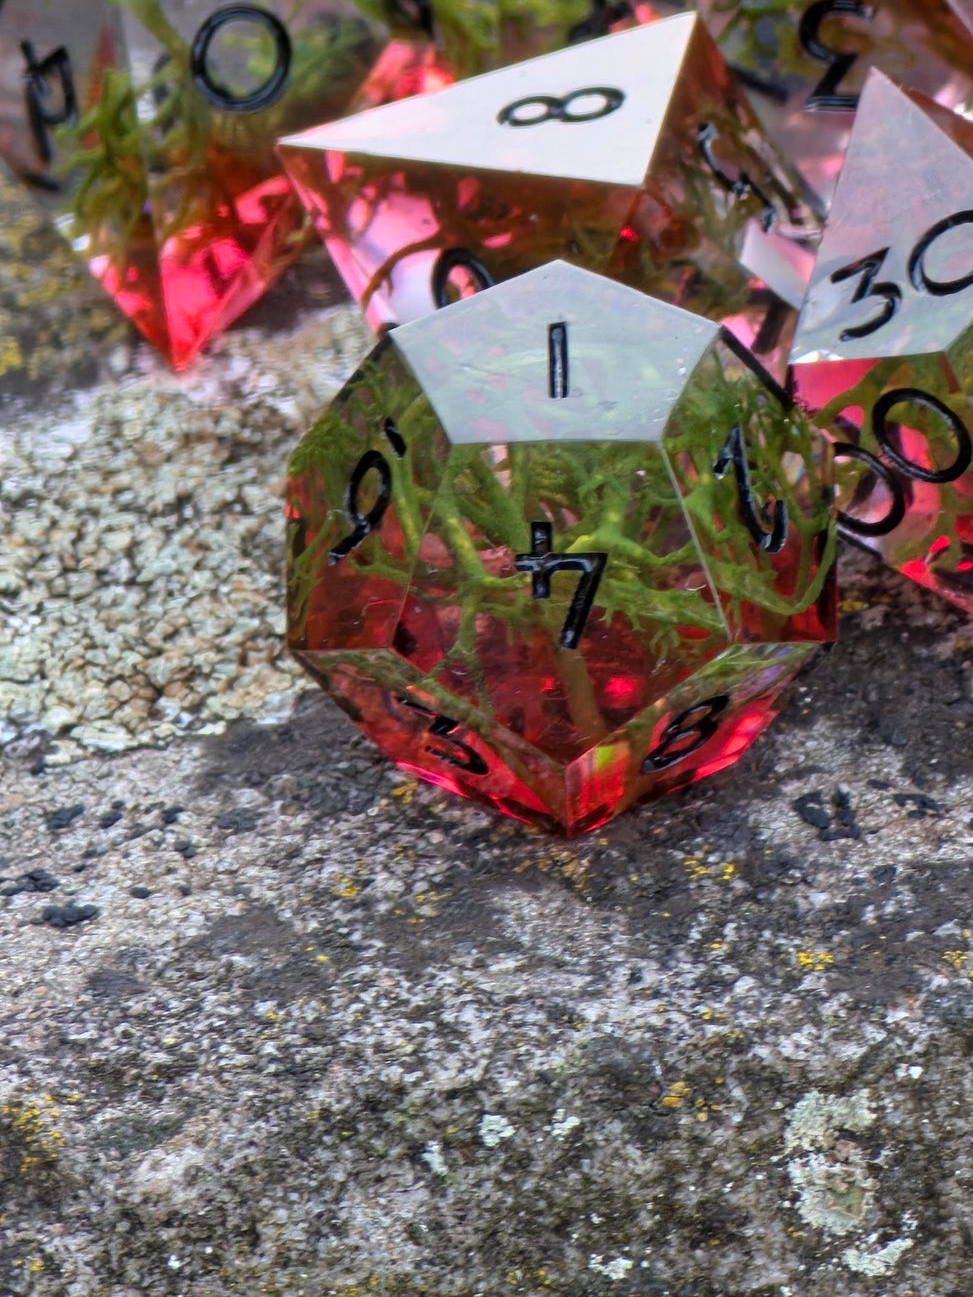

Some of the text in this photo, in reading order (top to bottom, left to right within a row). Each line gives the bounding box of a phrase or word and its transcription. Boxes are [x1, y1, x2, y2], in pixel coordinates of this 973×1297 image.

[497, 84, 626, 127] 8
[547, 320, 570, 399] 1
[514, 520, 607, 650] 4
